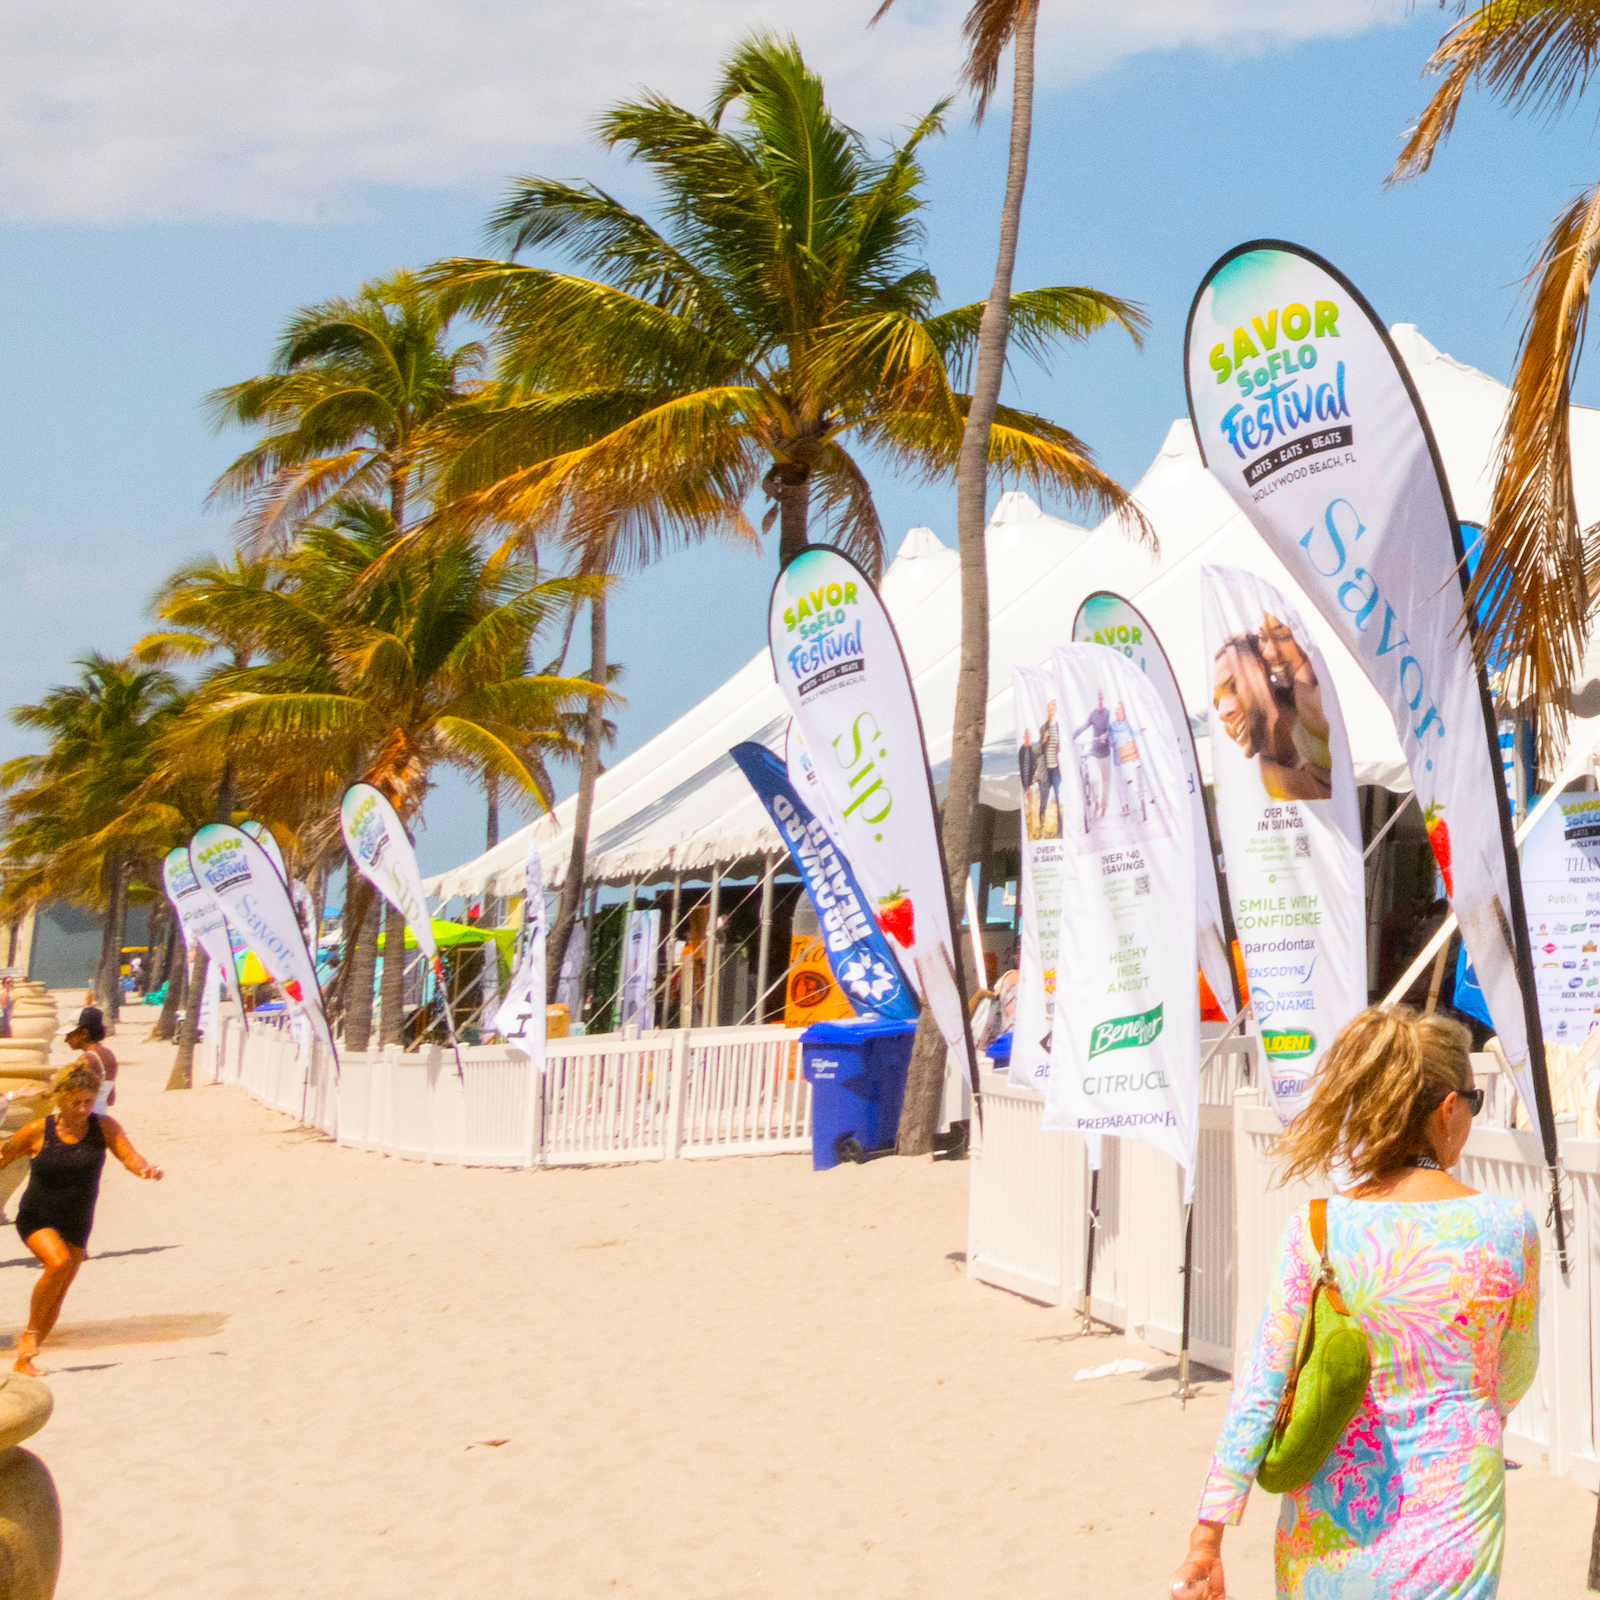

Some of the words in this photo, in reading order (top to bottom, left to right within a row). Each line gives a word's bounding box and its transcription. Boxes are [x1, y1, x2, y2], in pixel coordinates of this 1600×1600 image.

[1209, 300, 1341, 385] SAVOR
[1237, 344, 1317, 398] SoFLO
[1220, 360, 1350, 460] Festival
[1252, 460, 1272, 479] ARTS
[1280, 444, 1303, 462] EATS
[1312, 431, 1342, 448] BEATS
[1253, 469, 1307, 503] HOLLYWOOD
[1309, 457, 1344, 476] BEACH,
[1345, 452, 1357, 464] FL
[783, 581, 858, 632] SAVOR
[798, 608, 846, 641] SoFLO
[787, 619, 864, 680] Festival
[1300, 498, 1446, 772] Savor.
[800, 681, 838, 707] HOLLYWOOD
[831, 711, 893, 843] Sip.
[1257, 821, 1269, 831] IN
[1272, 818, 1304, 831] SVINGS
[1264, 808, 1282, 819] OER
[197, 838, 244, 865] SAVOR
[773, 794, 852, 953] BROWARD
[806, 815, 873, 942] HEALTH
[1236, 912, 1322, 930] CONFIDENCE
[1239, 897, 1286, 912] SMILE
[1290, 895, 1318, 909] WITH
[1244, 937, 1316, 958] parodontax
[1077, 1111, 1164, 1129] PREPARATION
